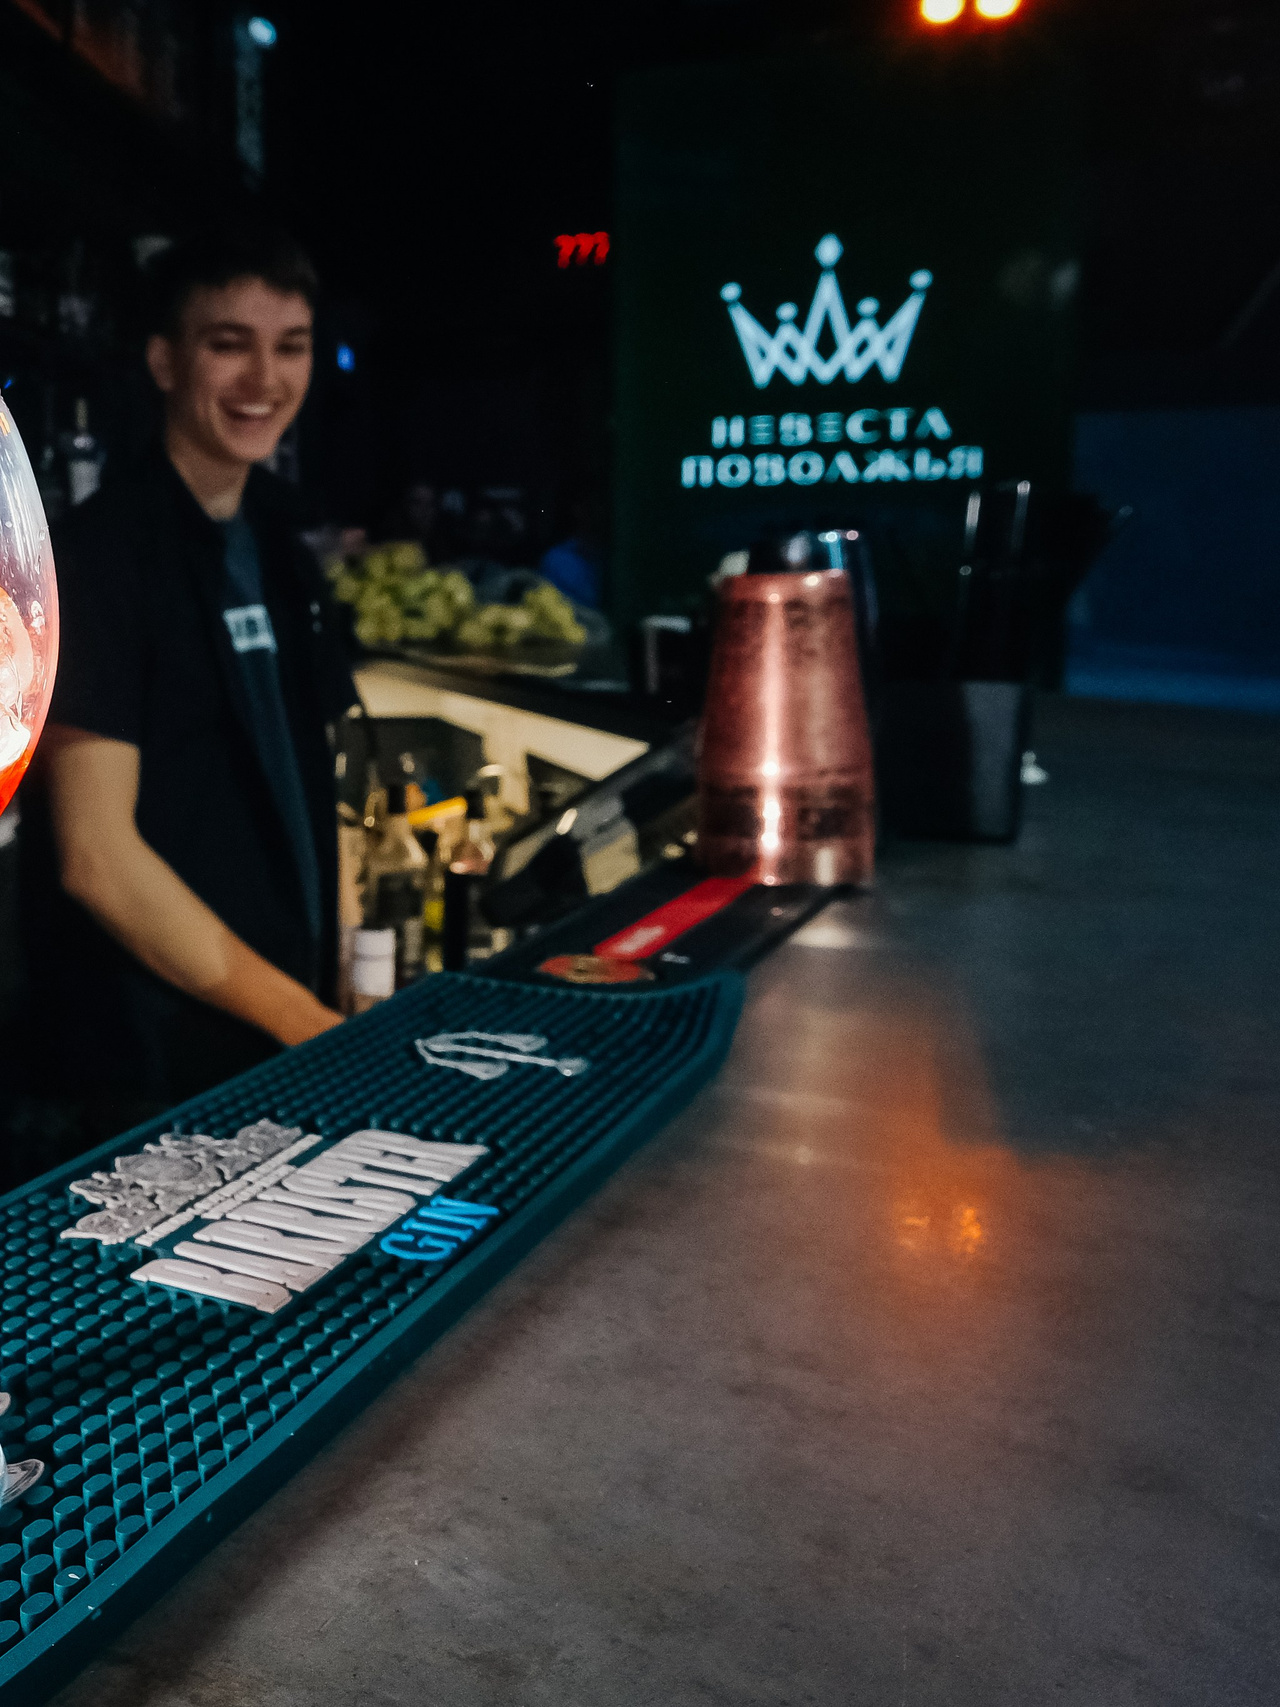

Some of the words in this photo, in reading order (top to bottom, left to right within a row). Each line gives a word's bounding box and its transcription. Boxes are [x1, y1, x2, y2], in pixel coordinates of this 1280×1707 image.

[711, 406, 953, 448] НЕВЕСТА
[680, 445, 984, 488] ПОВОЛЖЬЯ
[130, 1129, 491, 1314] BARRISTER
[380, 1194, 499, 1261] GIN
